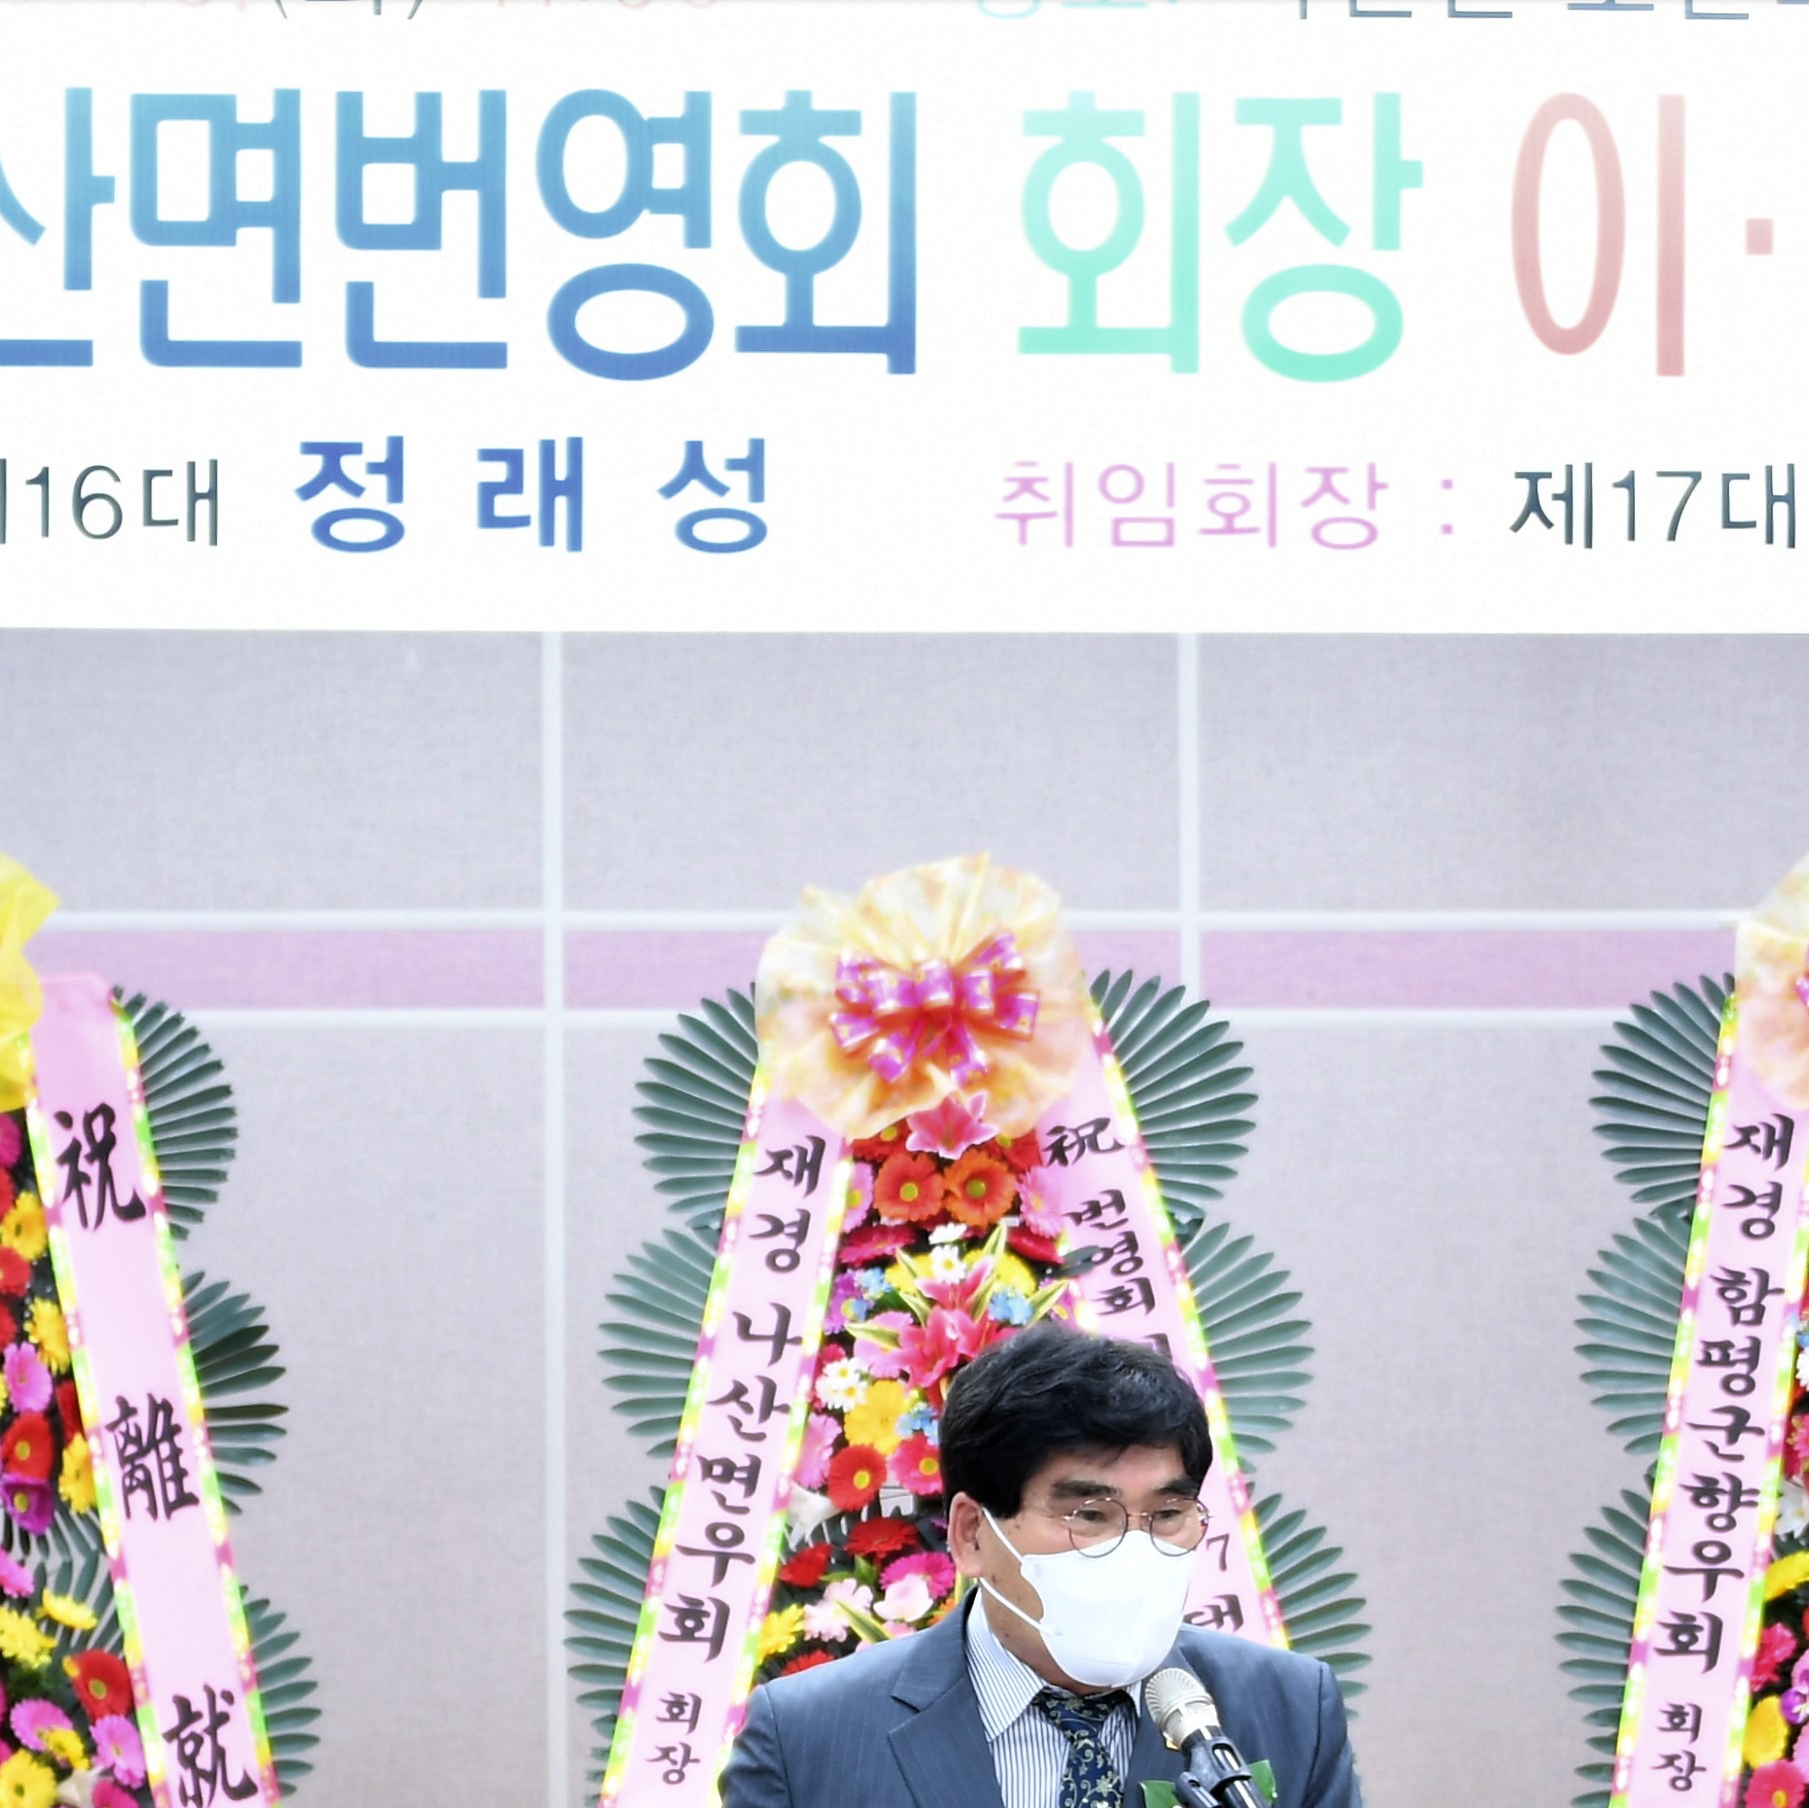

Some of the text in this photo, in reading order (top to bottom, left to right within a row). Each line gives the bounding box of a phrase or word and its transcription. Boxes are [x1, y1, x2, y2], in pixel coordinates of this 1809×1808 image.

[1018, 92, 1423, 382] 회장
[994, 460, 1391, 552] 취임회장
[1509, 460, 1799, 552] 제17대
[748, 1134, 827, 1274] 재경
[1043, 1116, 1125, 1168] 祝
[1723, 1112, 1795, 1242] 재경
[53, 1100, 147, 1232] 祝
[103, 1392, 199, 1522] 離
[1063, 1188, 1157, 1318] 번영회
[647, 1690, 703, 1786] 회장
[1655, 1702, 1707, 1792] 회장
